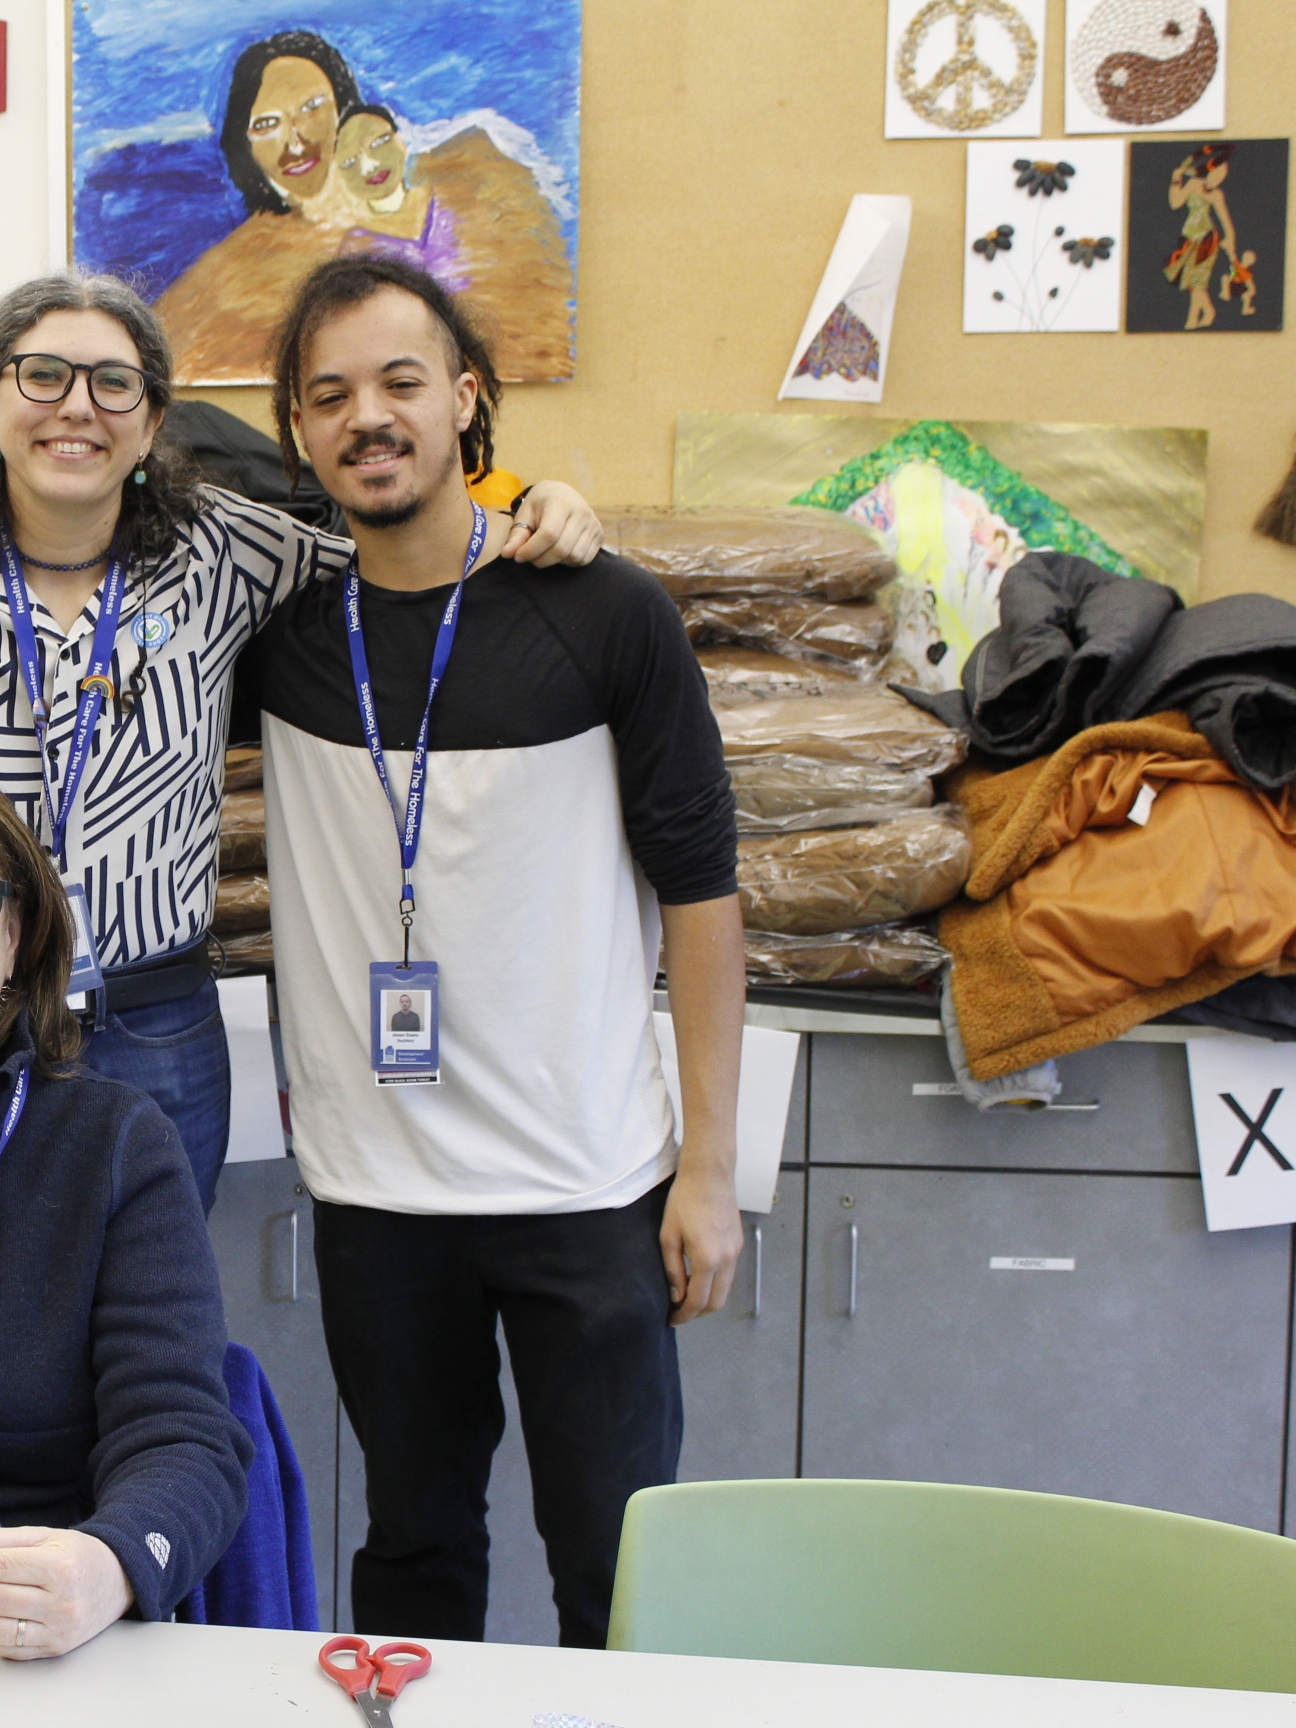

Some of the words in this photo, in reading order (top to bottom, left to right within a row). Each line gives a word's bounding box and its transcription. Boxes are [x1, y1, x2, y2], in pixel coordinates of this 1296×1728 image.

[475, 515, 484, 534] Care
[471, 535, 482, 553] For
[5, 550, 18, 577] Care
[10, 578, 25, 614] Health
[347, 577, 358, 596] Care
[347, 597, 360, 632] Health
[80, 700, 95, 727] Care
[75, 728, 90, 749] For
[361, 682, 376, 735] Homeless
[371, 737, 381, 758] The
[377, 761, 386, 778] For
[418, 718, 428, 743] Care
[70, 750, 82, 770] The
[414, 746, 424, 765] For
[410, 768, 422, 789] The
[56, 770, 76, 825] Homeless
[405, 792, 421, 847] Homeless
[6, 1096, 21, 1136] Health
[1218, 1088, 1295, 1177] X
